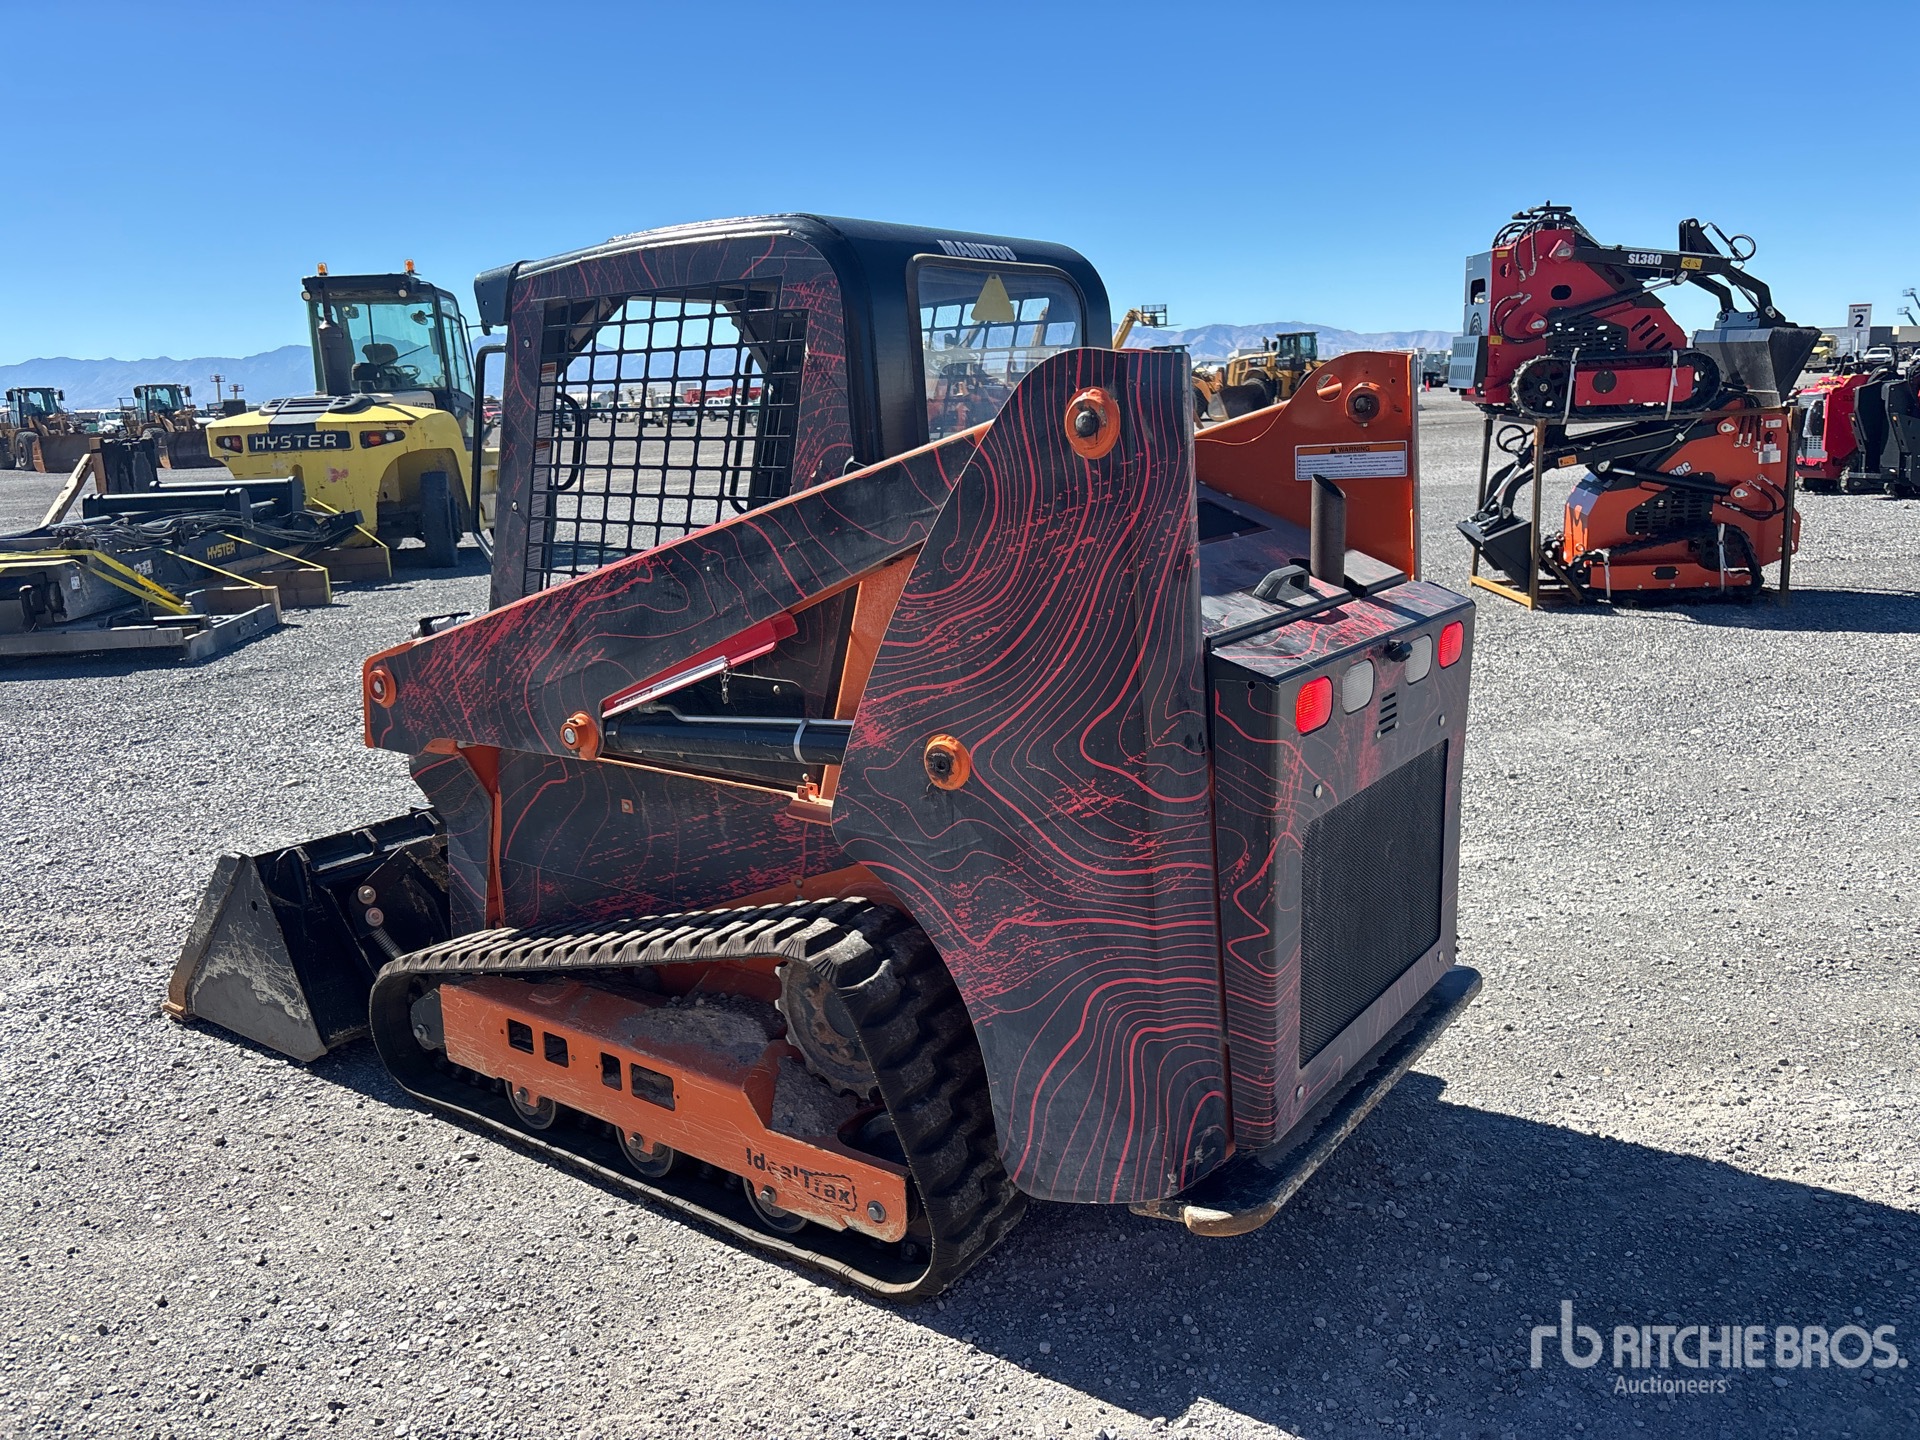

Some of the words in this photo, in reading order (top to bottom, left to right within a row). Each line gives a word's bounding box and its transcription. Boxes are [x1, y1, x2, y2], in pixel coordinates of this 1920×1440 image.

[936, 240, 1017, 261] MANITOU
[1628, 253, 1662, 265] SL380
[1854, 314, 1864, 327] 2
[255, 433, 337, 449] HYSTER
[206, 541, 236, 560] HYSTER
